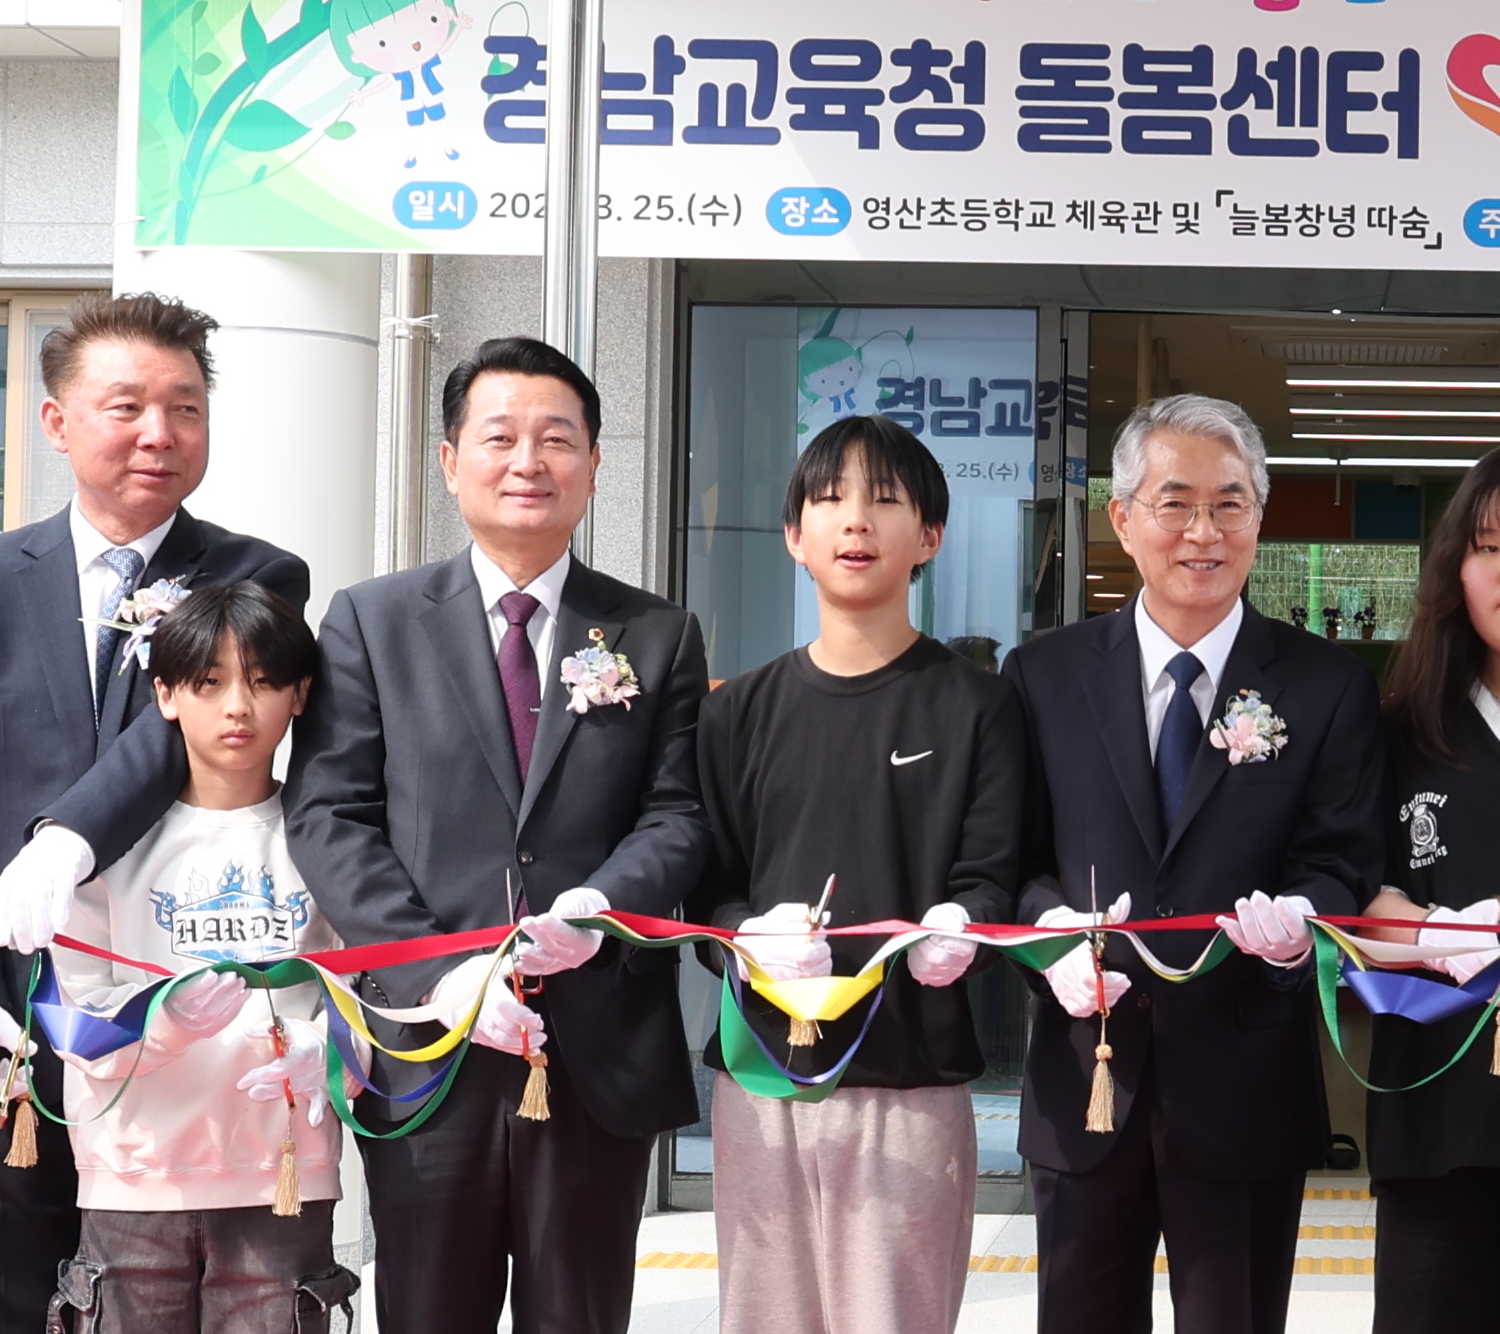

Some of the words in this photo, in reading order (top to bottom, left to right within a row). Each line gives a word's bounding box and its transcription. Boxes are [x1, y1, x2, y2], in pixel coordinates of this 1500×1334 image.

[480, 33, 987, 153] 경남교육청
[1015, 42, 1420, 160] 돌봄센터
[408, 190, 466, 221] 일시
[633, 193, 743, 227] 25.(수)
[780, 195, 841, 226] 장소
[862, 195, 1057, 233] 영산초등학교
[1065, 199, 1164, 235] 체육관
[1172, 202, 1200, 236] 및
[1366, 204, 1442, 250] 따숨」
